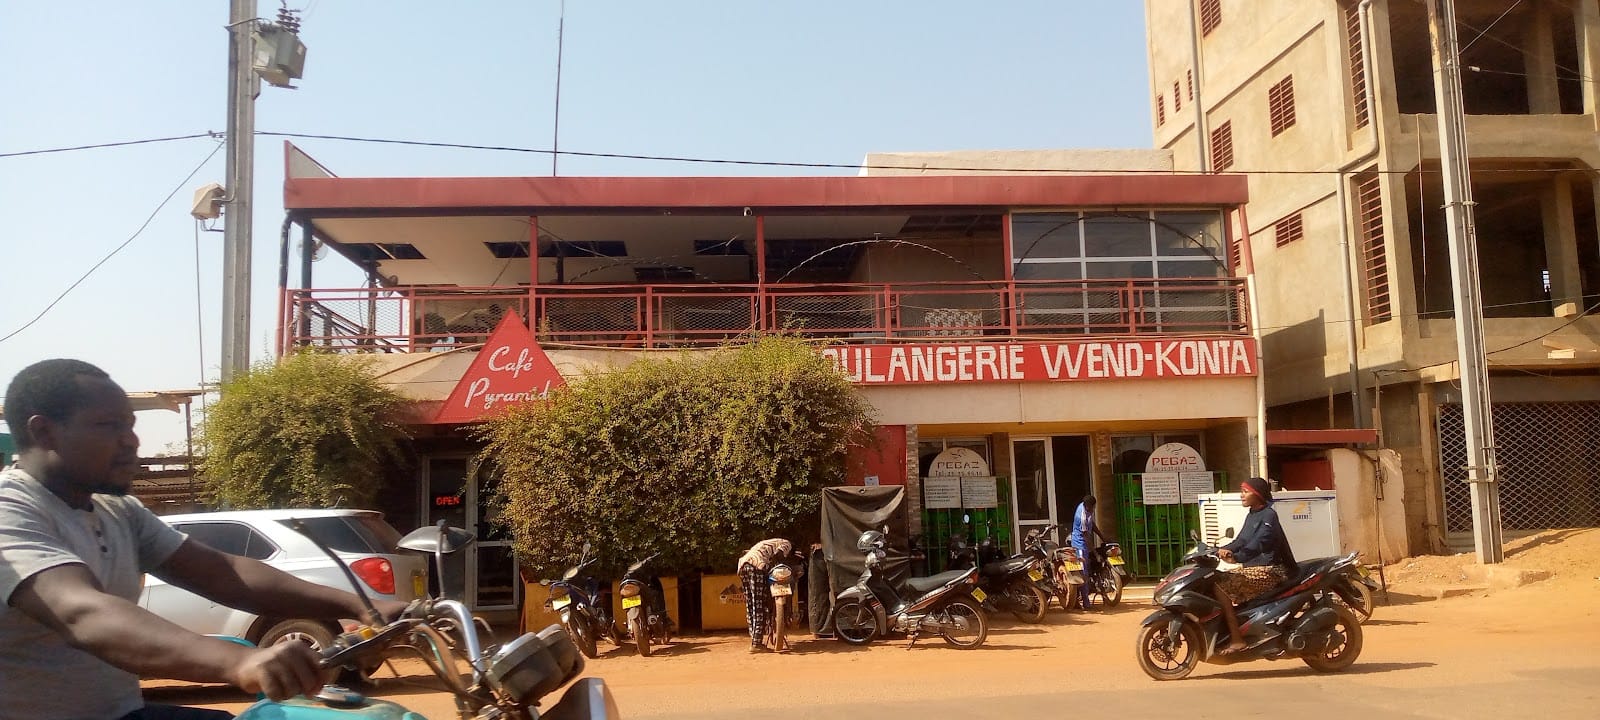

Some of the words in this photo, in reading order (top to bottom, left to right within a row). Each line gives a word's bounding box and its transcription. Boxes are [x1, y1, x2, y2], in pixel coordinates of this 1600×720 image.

[488, 345, 534, 379] Café
[823, 345, 1025, 383] OULANGERIE
[1040, 340, 1252, 380] WEND-KONTA
[1152, 456, 1197, 466] PEGAZ
[436, 496, 460, 505] OPEN
